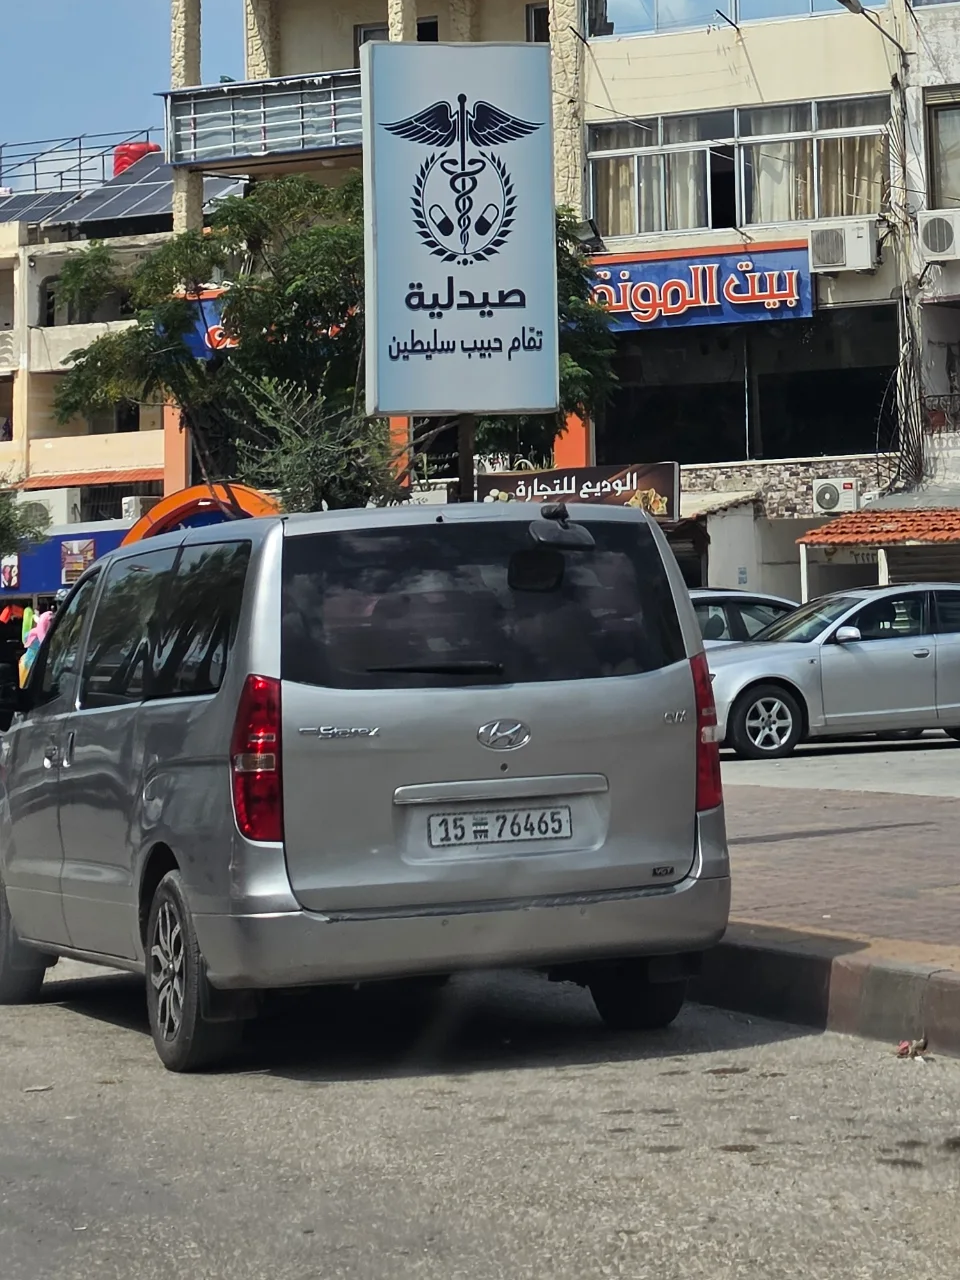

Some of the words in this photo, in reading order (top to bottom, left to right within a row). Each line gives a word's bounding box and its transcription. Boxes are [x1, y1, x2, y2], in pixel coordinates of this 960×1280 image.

[404, 276, 526, 319] صيدلية
[723, 261, 799, 308] بيت
[388, 328, 456, 361] سليطين
[460, 336, 503, 359] حبيب
[515, 475, 576, 502] للتجارة
[579, 471, 638, 498] الوديع
[438, 817, 465, 842] 15
[495, 811, 563, 838] 76465
